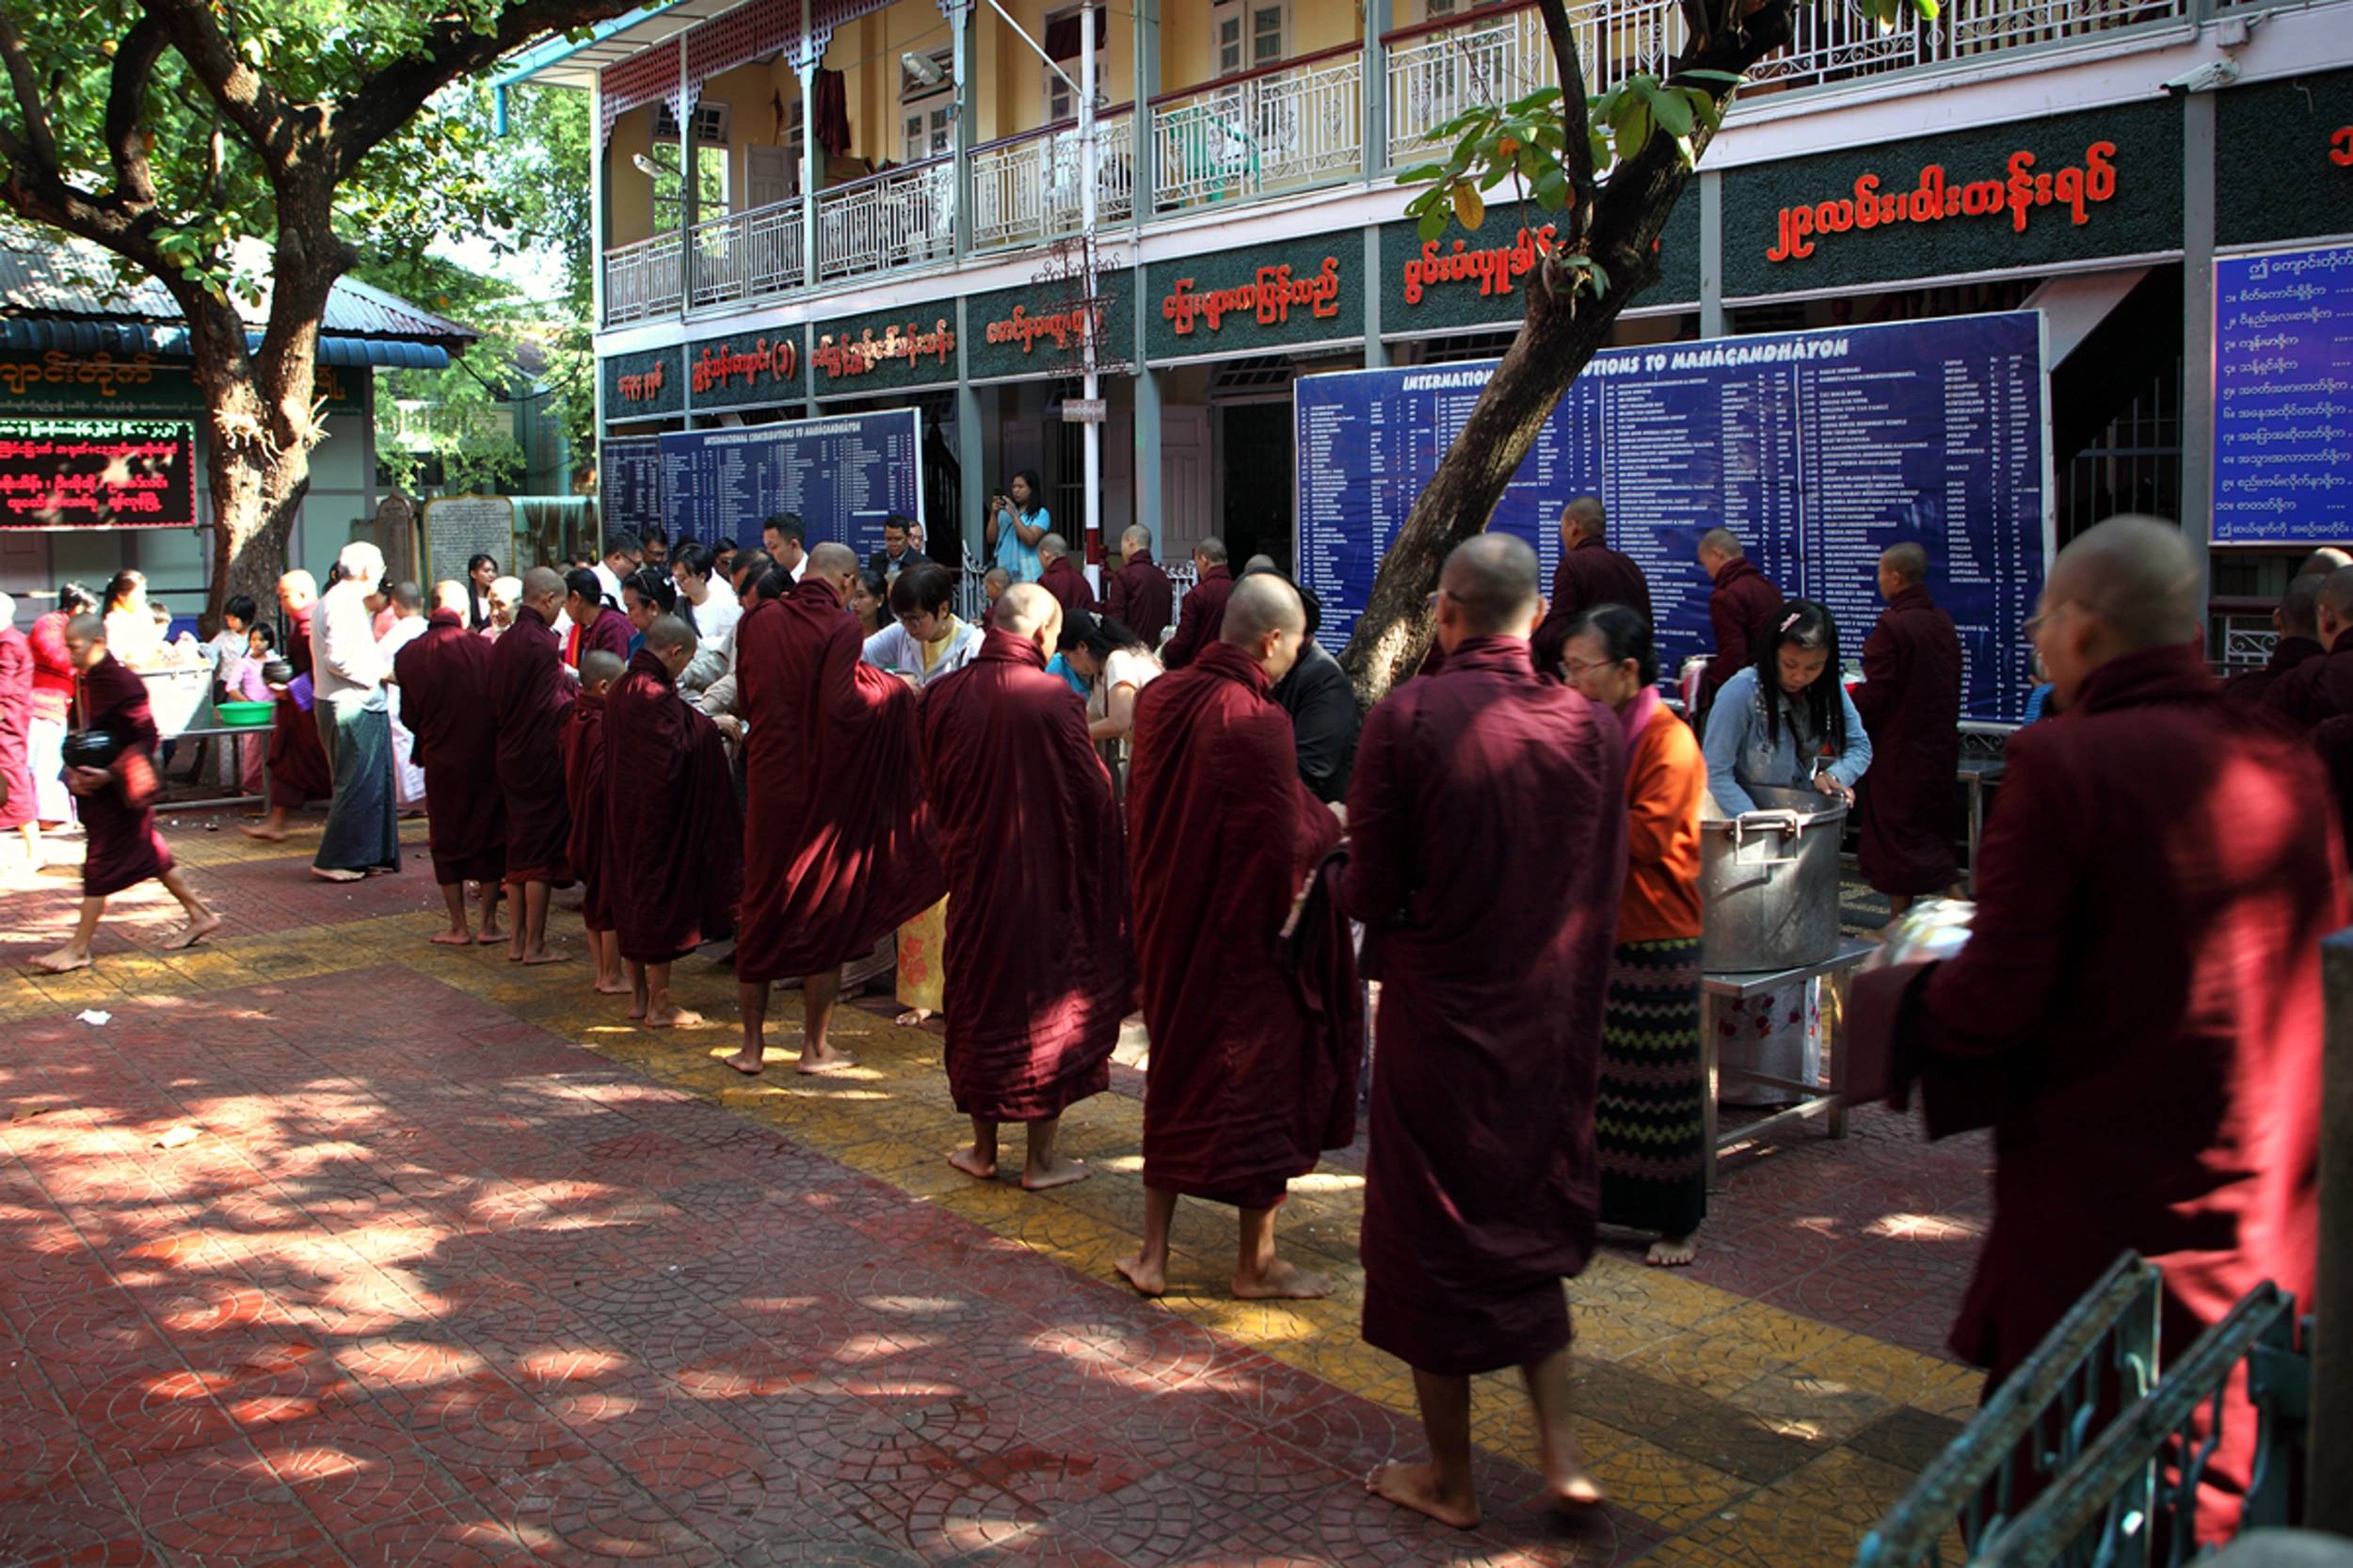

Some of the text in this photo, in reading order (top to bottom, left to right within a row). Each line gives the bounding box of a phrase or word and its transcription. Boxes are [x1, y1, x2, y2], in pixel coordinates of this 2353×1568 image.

[1402, 369, 1495, 392] INTERNATION
[1644, 353, 1668, 373] TO
[1671, 336, 1849, 371] MAHĀGANDHĀYON
